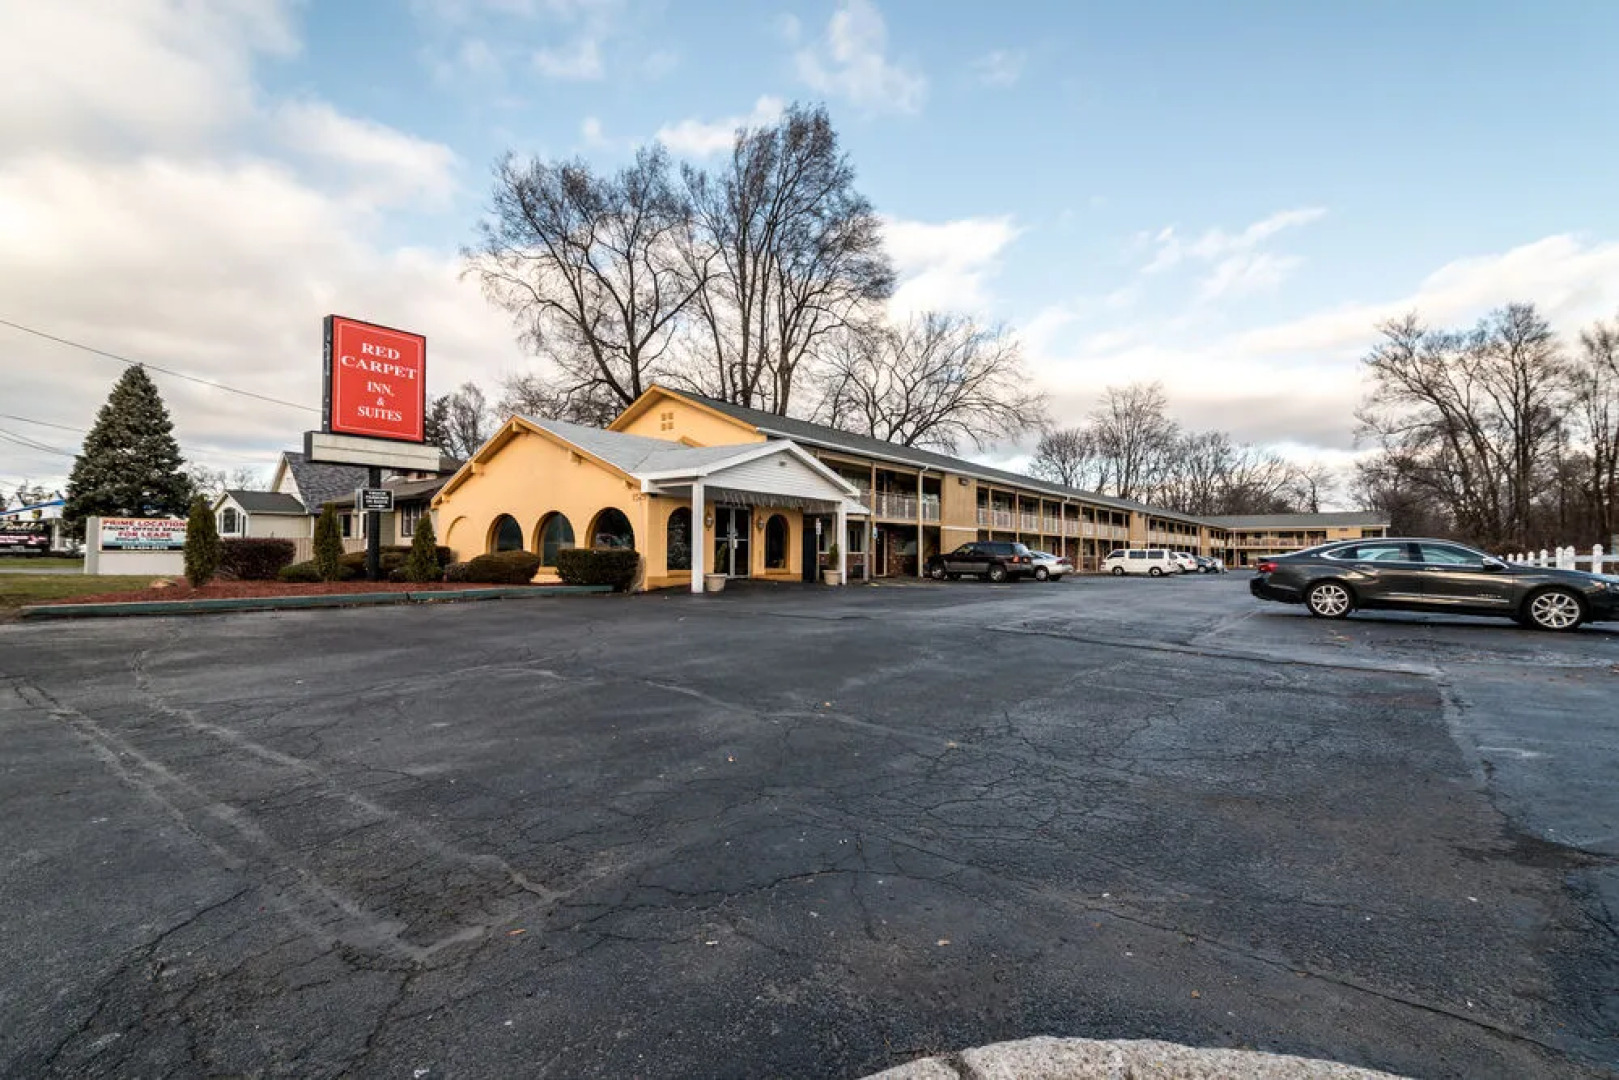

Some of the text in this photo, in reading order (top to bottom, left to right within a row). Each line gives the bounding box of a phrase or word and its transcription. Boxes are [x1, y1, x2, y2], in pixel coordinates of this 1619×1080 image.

[362, 343, 400, 360] RED
[342, 356, 417, 379] CARPET
[376, 397, 385, 406] &
[357, 405, 403, 422] SUITES
